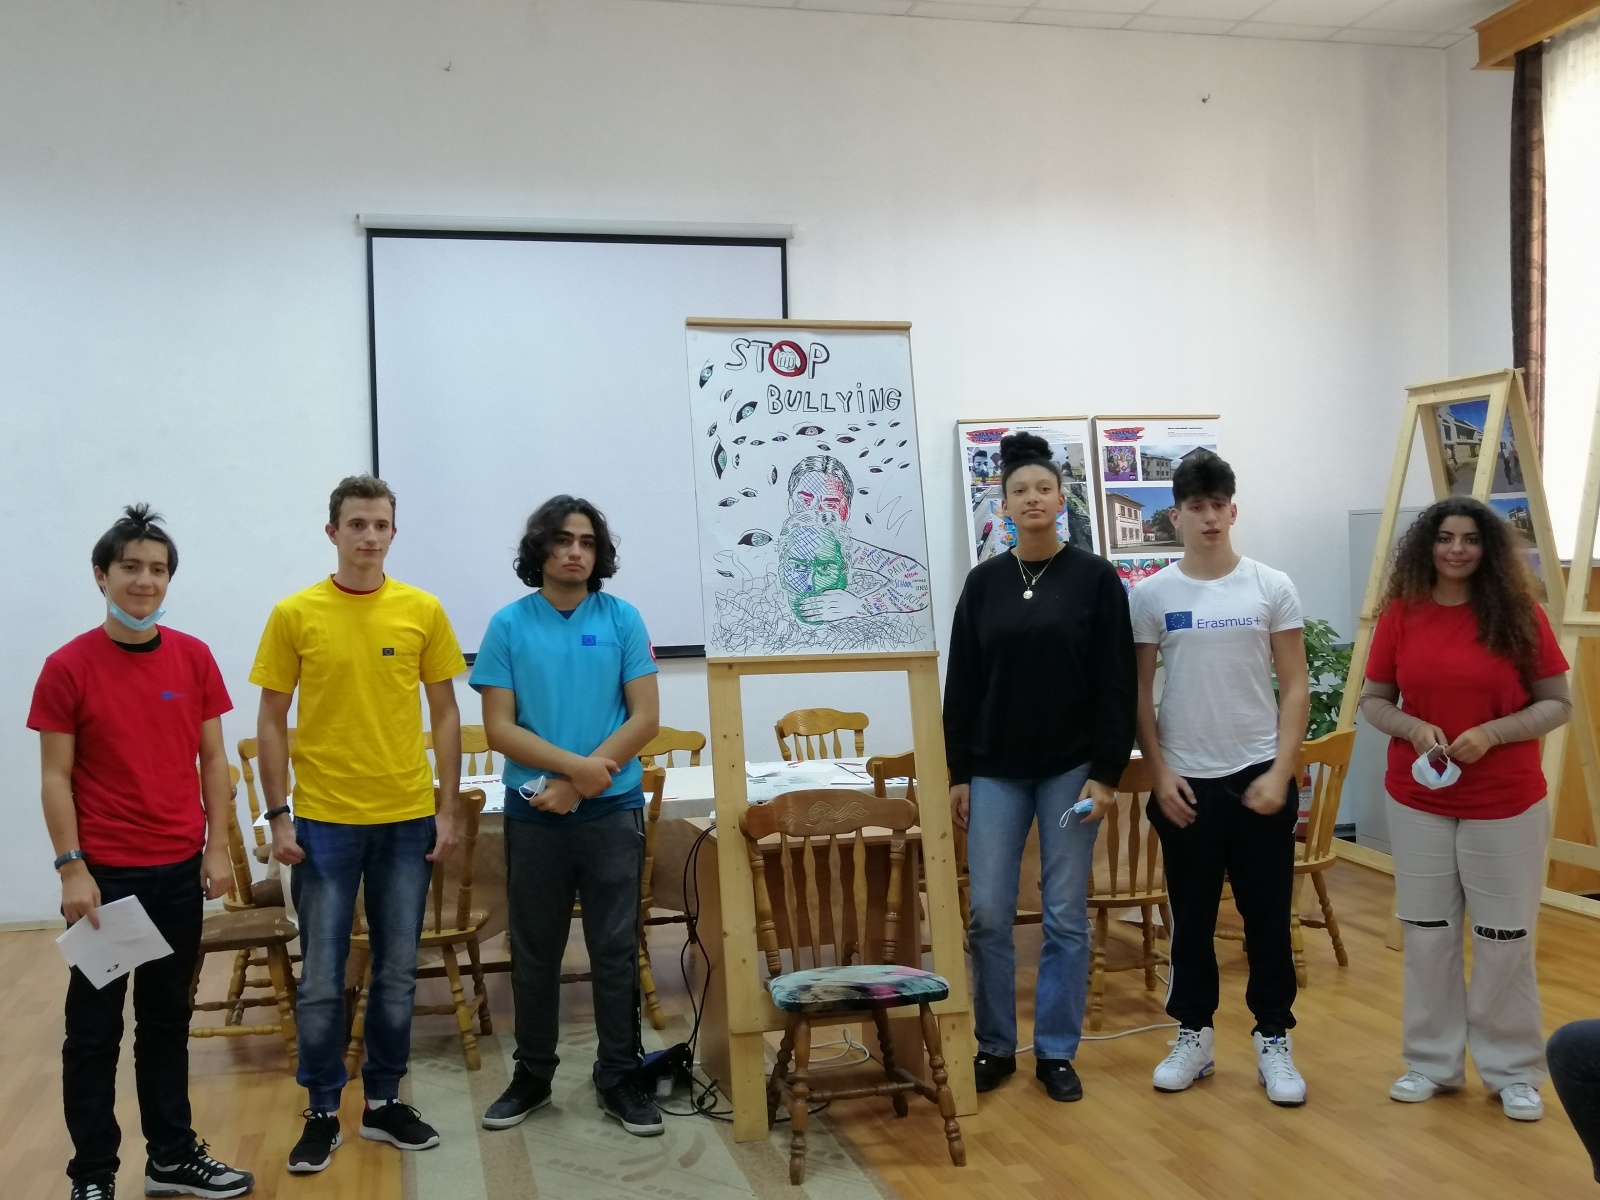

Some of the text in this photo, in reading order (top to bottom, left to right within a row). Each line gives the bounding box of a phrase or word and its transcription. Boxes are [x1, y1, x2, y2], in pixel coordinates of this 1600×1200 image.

[724, 338, 830, 379] STOP
[866, 551, 887, 570] FIGHT
[888, 559, 908, 578] PAIN
[895, 579, 913, 588] SCHOOL
[1197, 616, 1260, 629] Erasmus+
